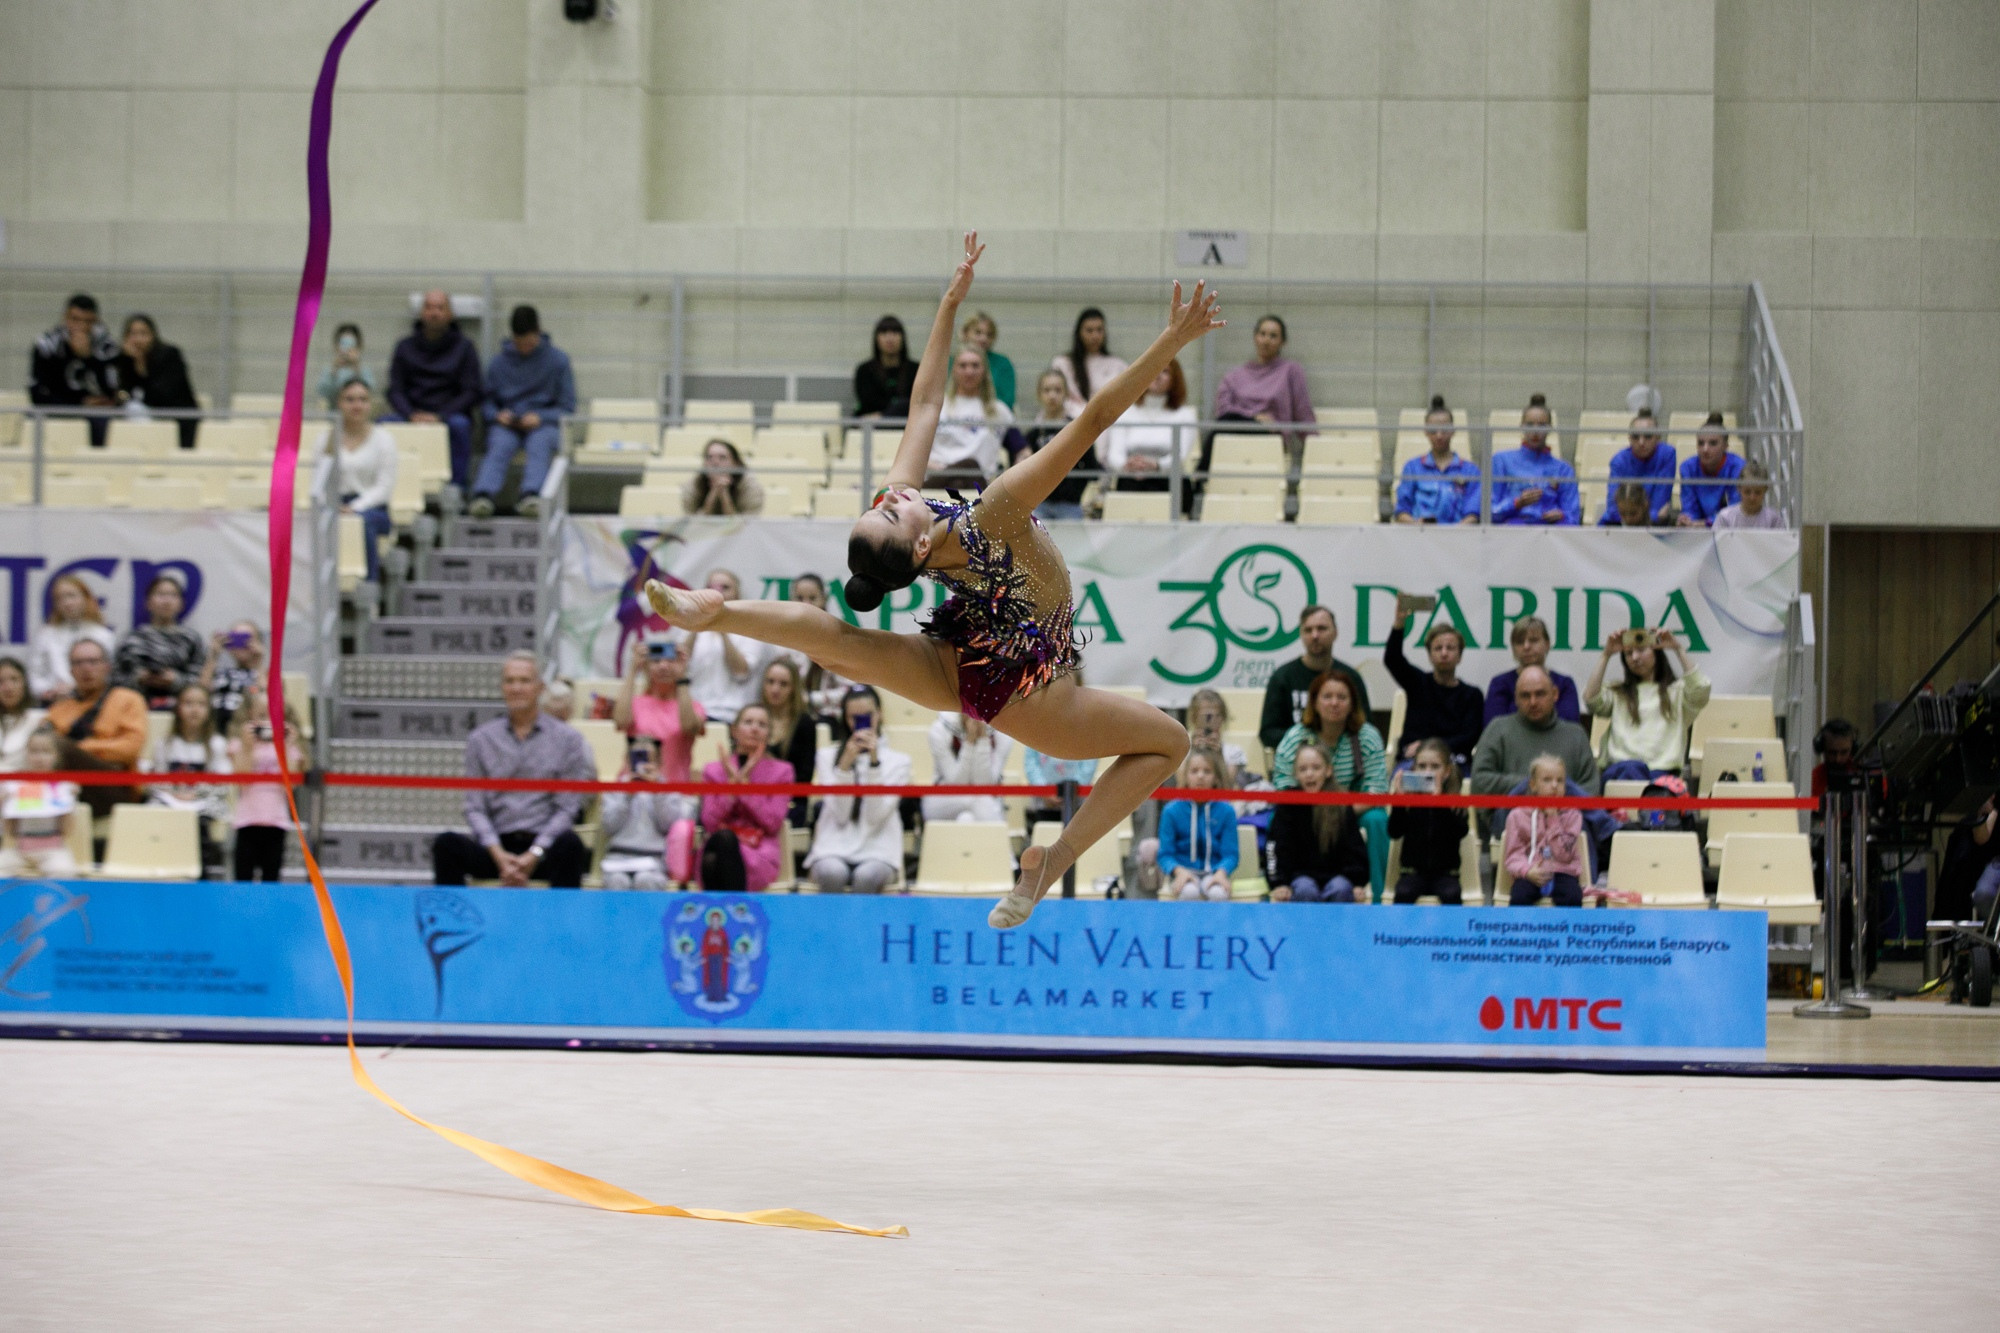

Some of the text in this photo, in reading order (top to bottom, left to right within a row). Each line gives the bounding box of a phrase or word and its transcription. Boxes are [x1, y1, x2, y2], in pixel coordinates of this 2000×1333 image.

[1352, 583, 1711, 652] DARIDA
[1468, 918, 1636, 936] Генеральный партнёр
[881, 923, 1286, 982] HELEN VALERY
[1373, 932, 1730, 954] Национальной команды Республики Беларусь
[1431, 951, 1672, 967] по гимнастике художественной
[932, 986, 1213, 1009] BELAMARKET
[1512, 997, 1623, 1031] МТС
